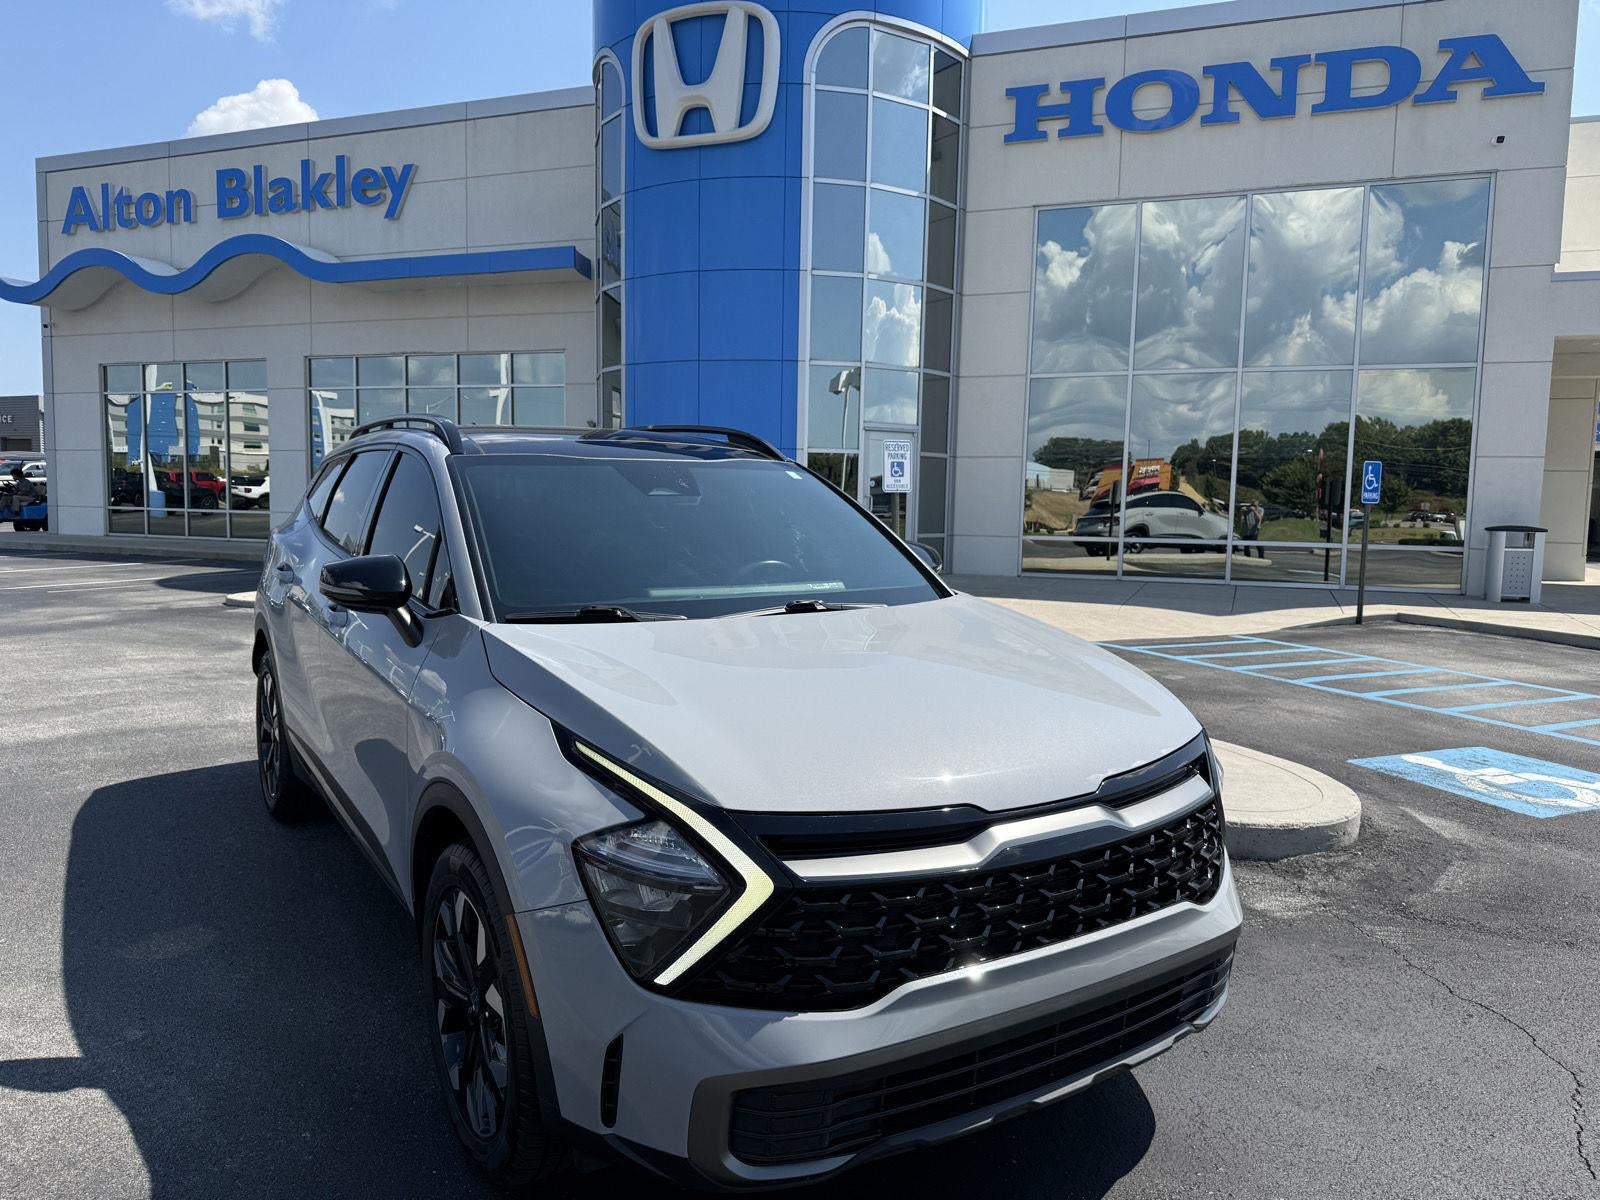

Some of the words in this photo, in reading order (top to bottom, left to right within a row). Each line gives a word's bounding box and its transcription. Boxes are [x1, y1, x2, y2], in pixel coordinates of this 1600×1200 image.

[1003, 33, 1546, 145] HONDA
[61, 182, 198, 236] Alton
[215, 154, 419, 221] Blakley
[885, 443, 910, 451] RESERVED
[887, 452, 907, 460] PARKING
